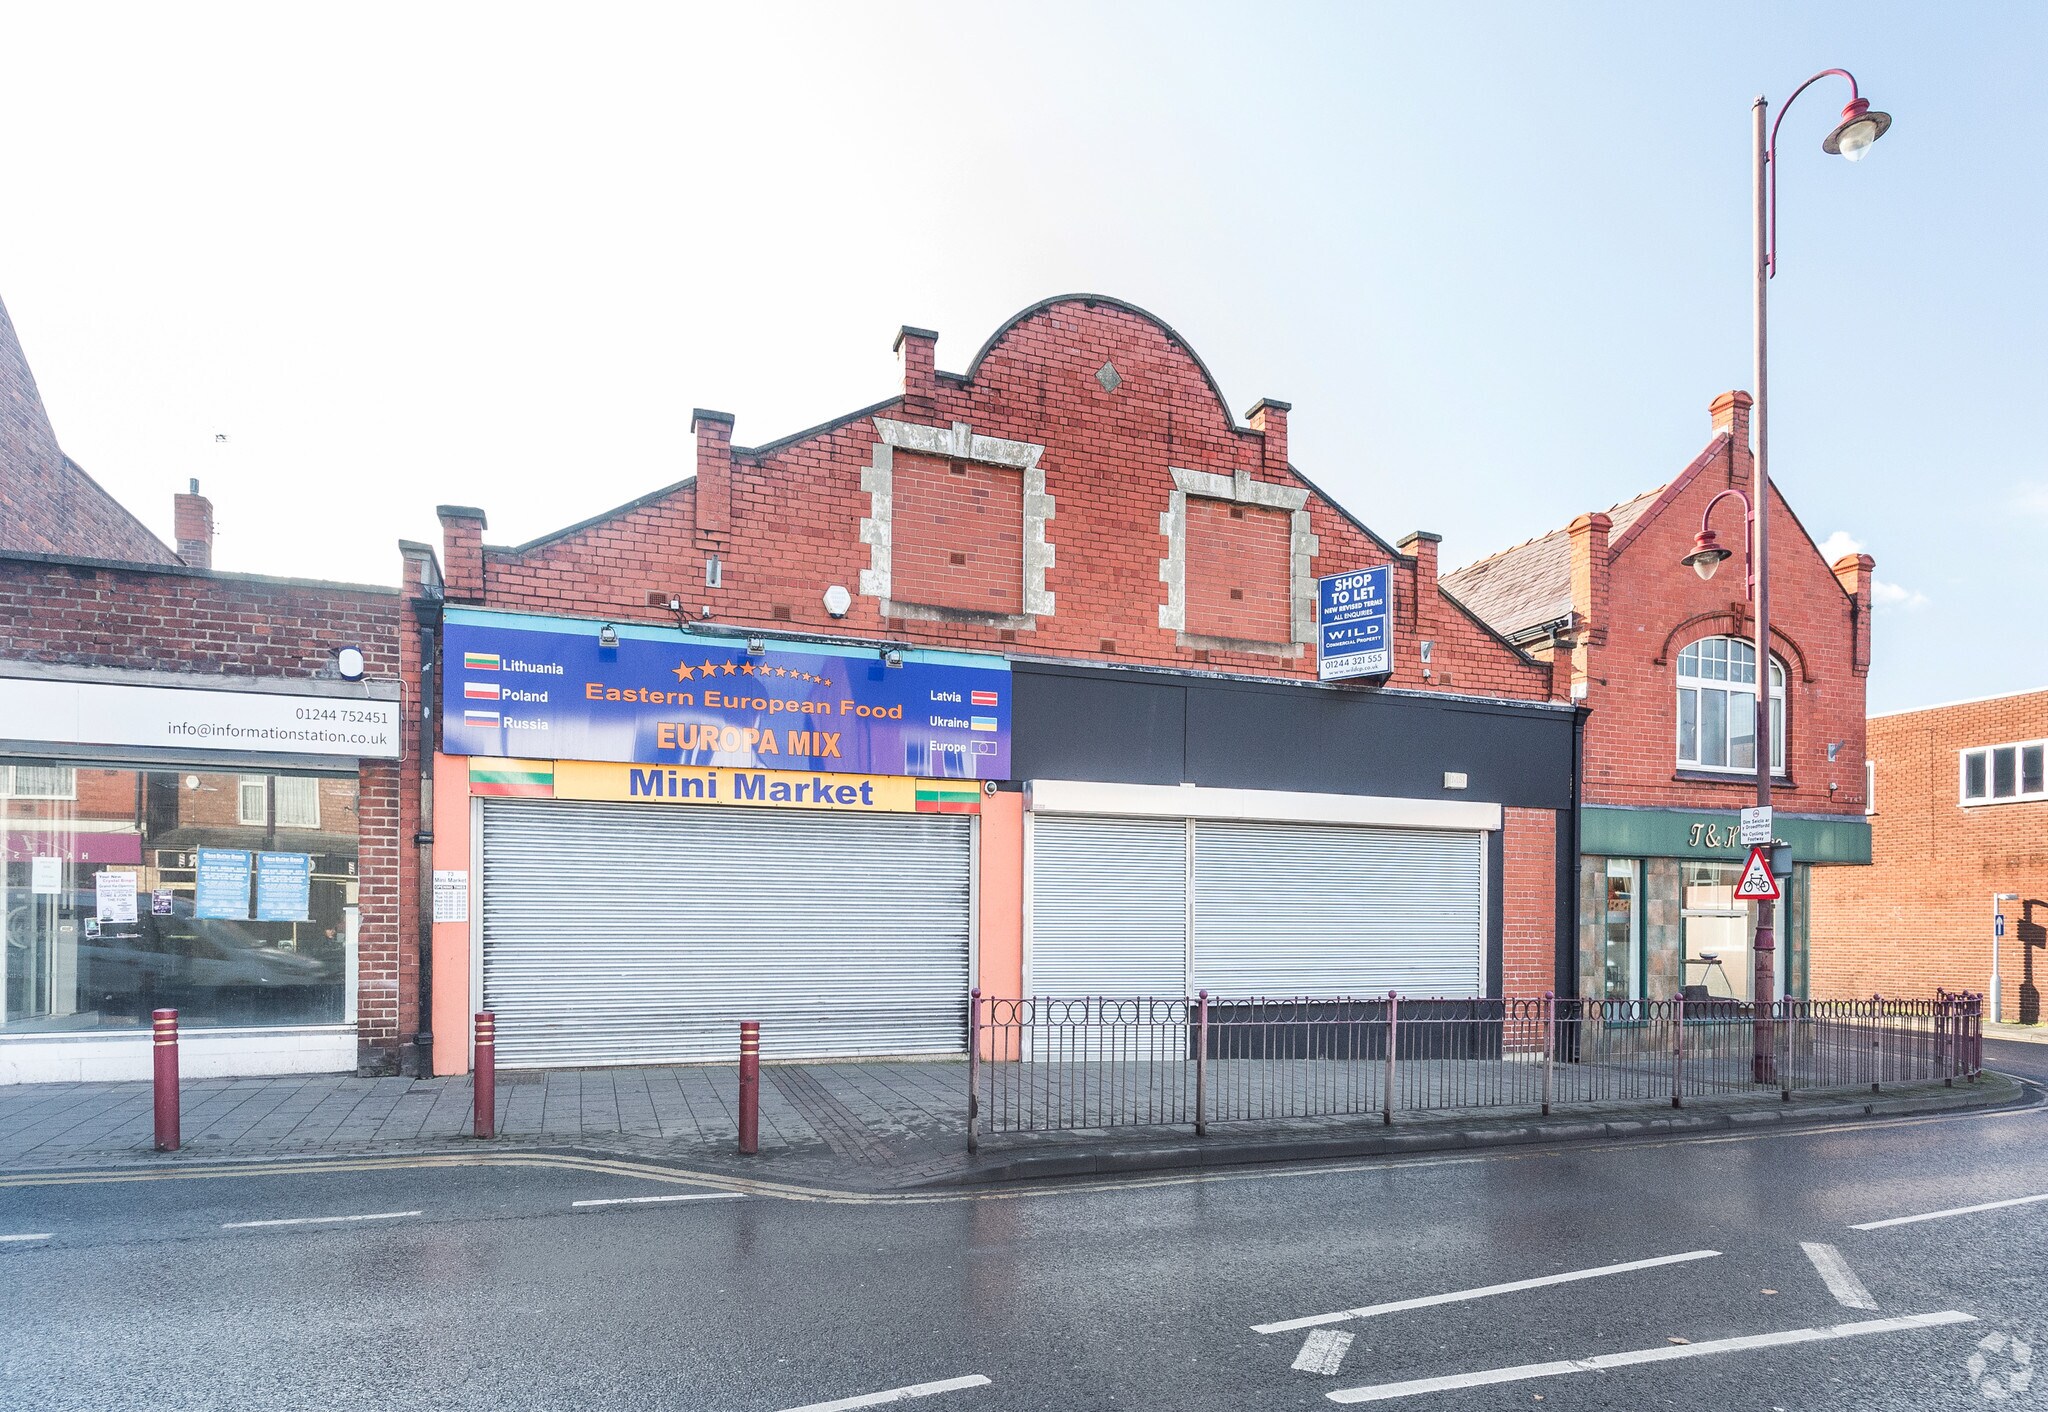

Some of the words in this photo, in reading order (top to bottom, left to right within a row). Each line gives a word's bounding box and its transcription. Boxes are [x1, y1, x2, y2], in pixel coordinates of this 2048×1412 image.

[1335, 574, 1372, 592] SHOP
[1331, 591, 1349, 605] TO
[1353, 586, 1375, 602] LET
[1324, 606, 1338, 615] NEW
[1339, 603, 1363, 612] REVISED
[1364, 598, 1383, 608] TERMS
[1344, 609, 1373, 619] ENQUIRIES
[1328, 625, 1379, 640] WILD
[502, 659, 564, 675] Lithuania
[1325, 659, 1350, 669] 01244
[1352, 656, 1365, 665] 321
[1368, 654, 1382, 663] 555
[502, 688, 549, 703] Poland
[585, 682, 695, 706] Eastern
[704, 690, 831, 714] European
[840, 699, 903, 720] Food
[930, 690, 962, 703] Latvia
[296, 707, 336, 721] 01244
[340, 710, 388, 724] 752451
[503, 716, 549, 730] Russia
[930, 715, 969, 728] Ukraine
[168, 722, 388, 745] info@informationstation.co.uk
[656, 721, 779, 755] EUROPA
[787, 730, 842, 758] MIX
[930, 740, 967, 754] Europe
[629, 768, 717, 799] Mini
[733, 772, 874, 806] Market
